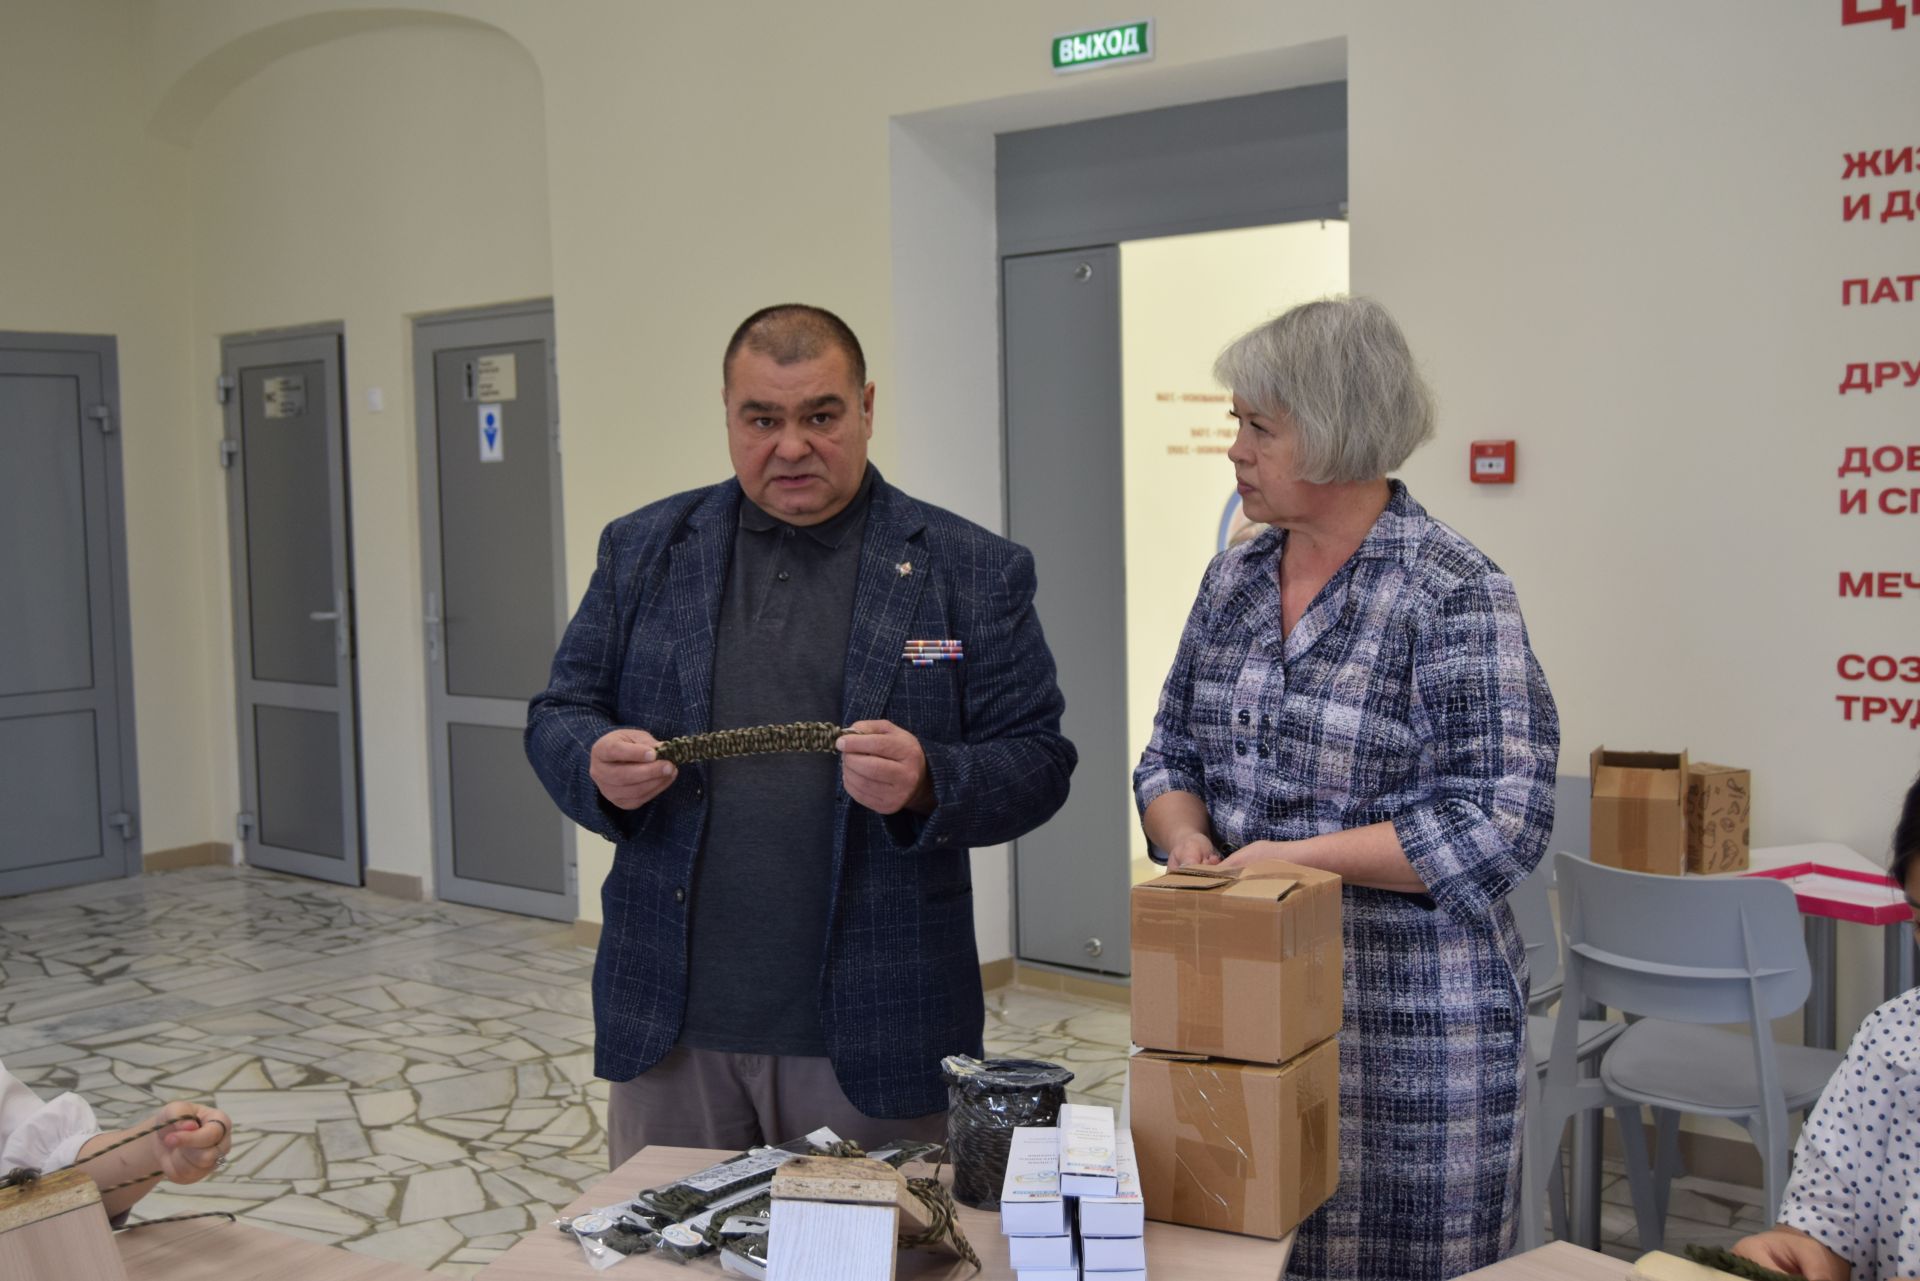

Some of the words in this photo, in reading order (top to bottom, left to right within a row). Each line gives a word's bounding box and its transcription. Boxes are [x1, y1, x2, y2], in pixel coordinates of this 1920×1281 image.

[1842, 0, 1920, 29] Ц
[1059, 27, 1140, 63] ВЫХОД
[1843, 146, 1920, 179] ЖИ
[1842, 194, 1871, 222] И
[1880, 190, 1920, 224] Д
[1842, 274, 1920, 305] ПАТ
[1839, 489, 1868, 514] И
[1839, 571, 1920, 598] МЕЧ
